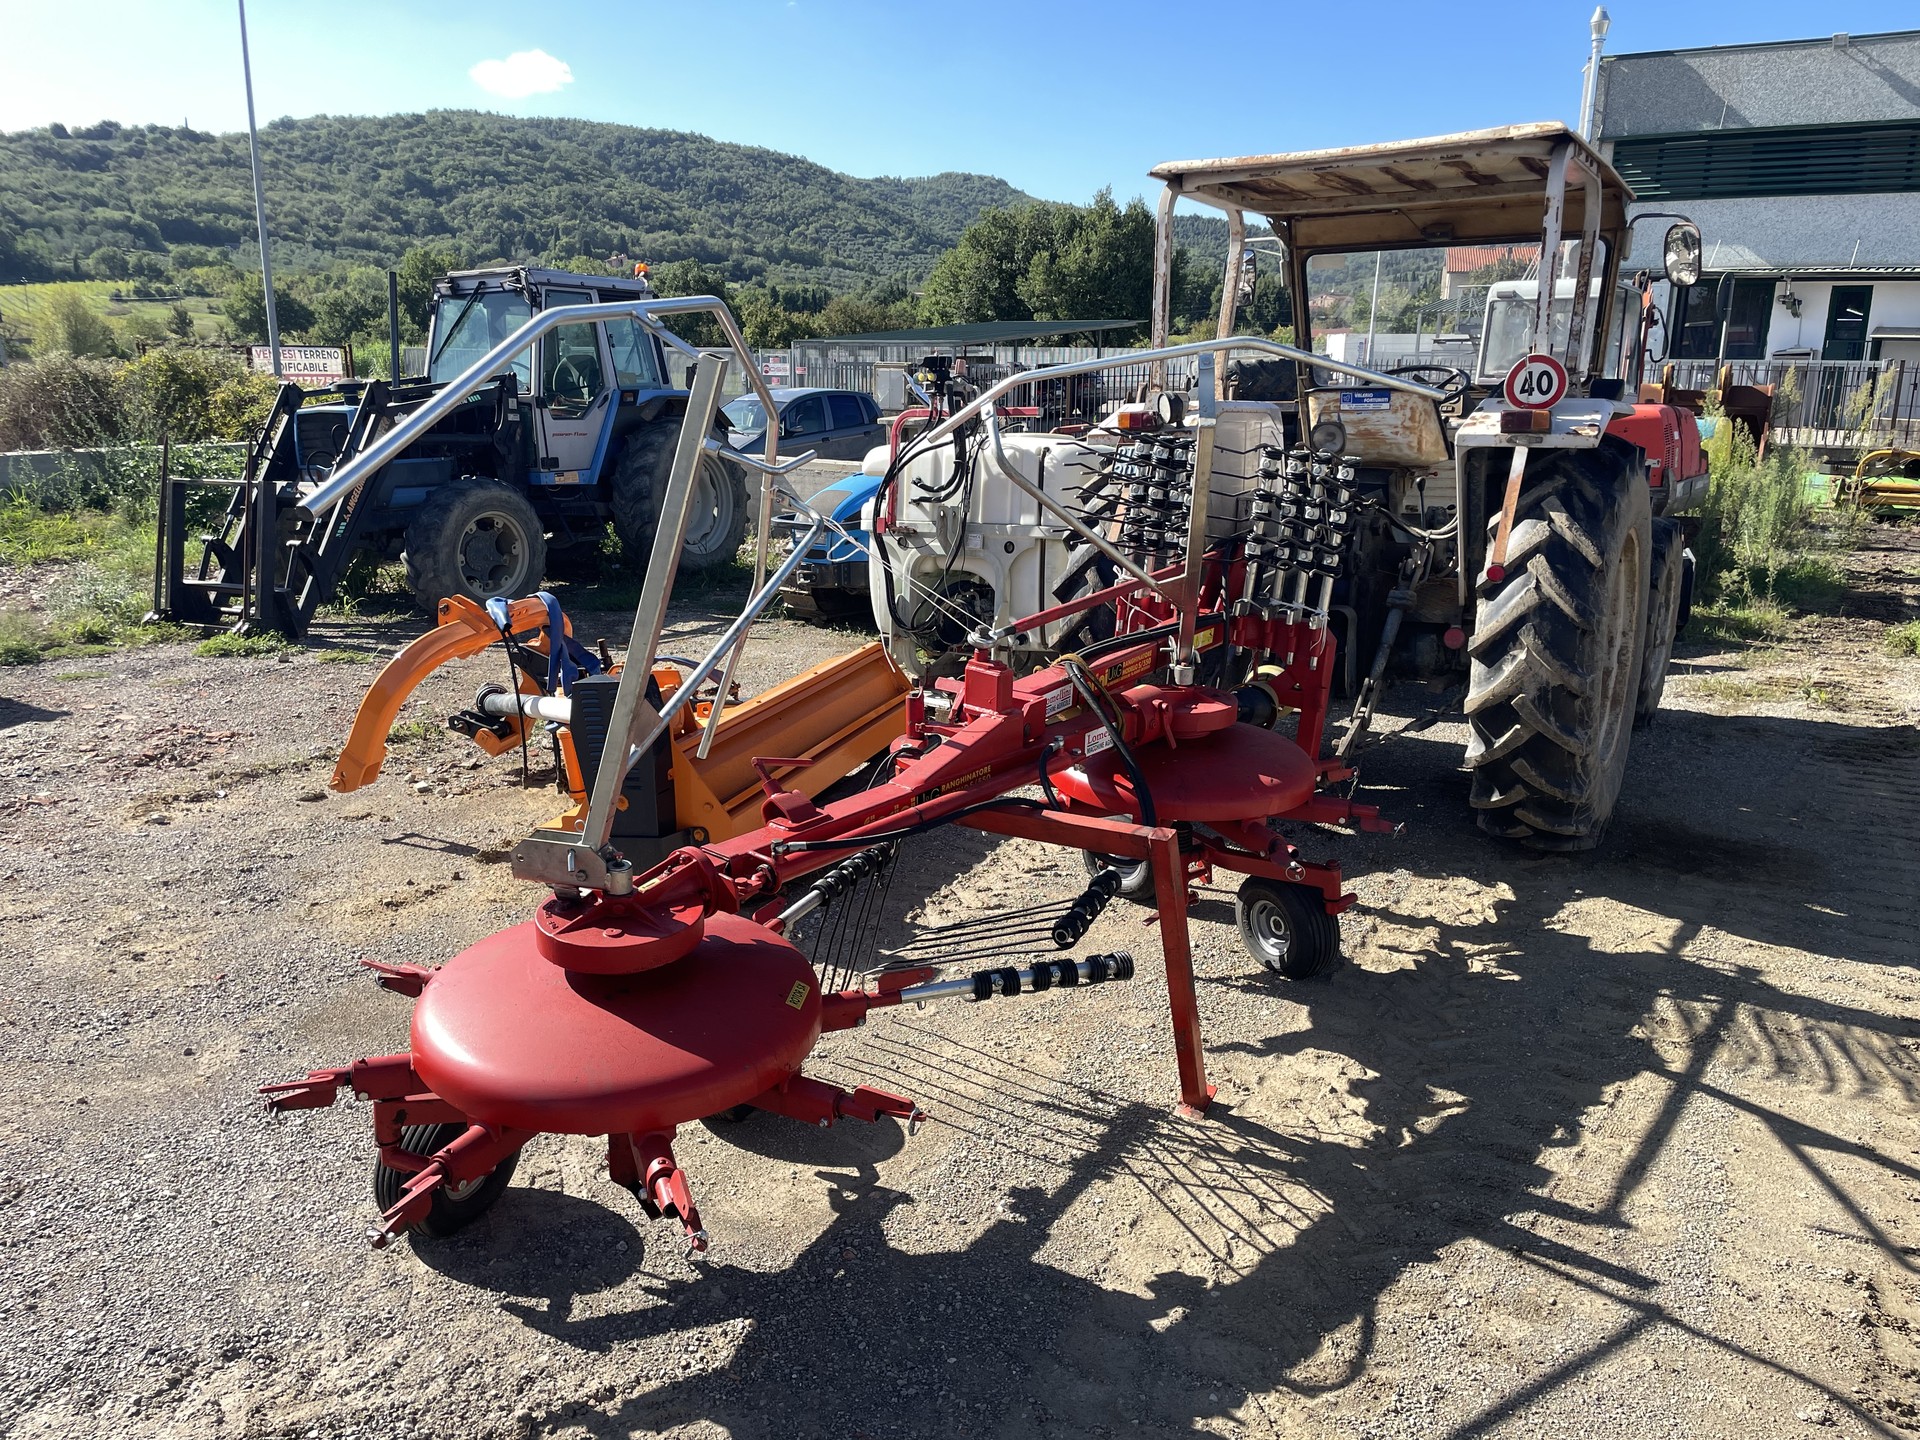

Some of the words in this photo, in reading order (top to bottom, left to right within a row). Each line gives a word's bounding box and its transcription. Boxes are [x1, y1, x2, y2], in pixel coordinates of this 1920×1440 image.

[255, 349, 296, 359] VEESI
[298, 349, 339, 360] TERRENO
[280, 362, 328, 372] DIFICABILE
[1519, 370, 1553, 396] 40
[346, 478, 366, 513] ANGELO
[941, 764, 992, 792] RANGHINATORE
